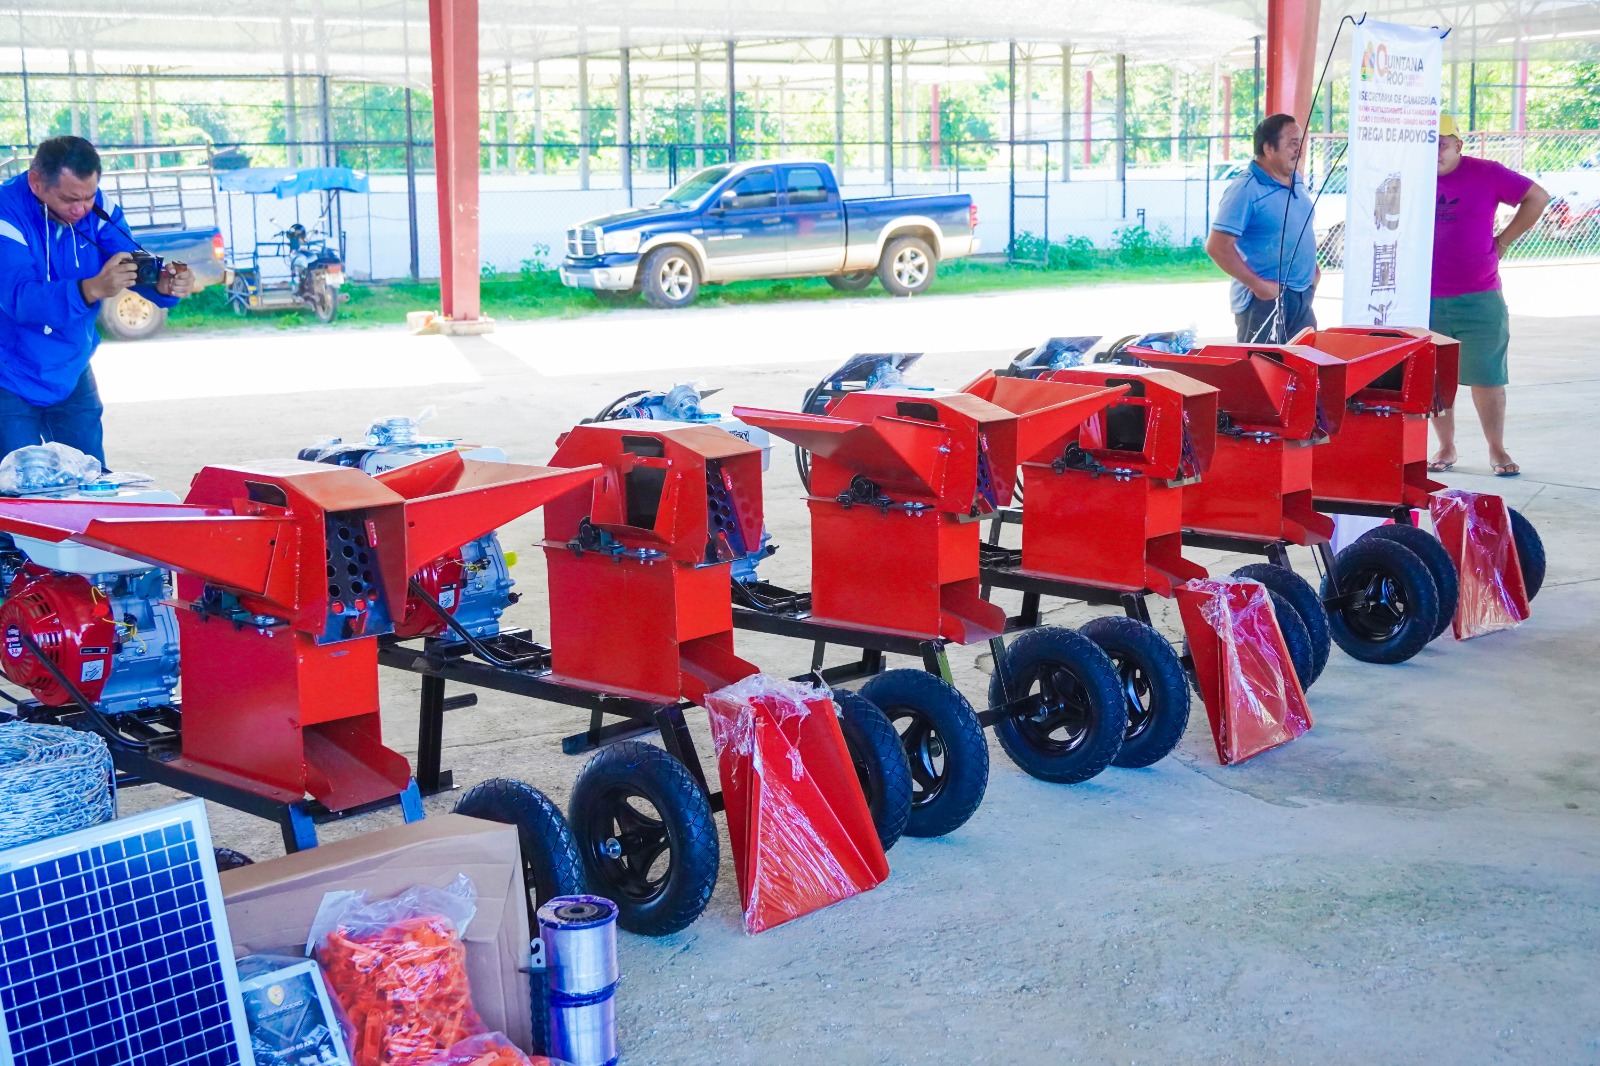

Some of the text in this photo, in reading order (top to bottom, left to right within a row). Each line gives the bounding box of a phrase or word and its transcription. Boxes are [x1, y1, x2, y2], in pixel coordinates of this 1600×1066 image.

[1376, 43, 1424, 77] QUINTANA
[1387, 71, 1404, 86] ROO
[1394, 94, 1402, 104] DE
[1386, 128, 1397, 142] DE
[1398, 128, 1437, 144] APOYOS
